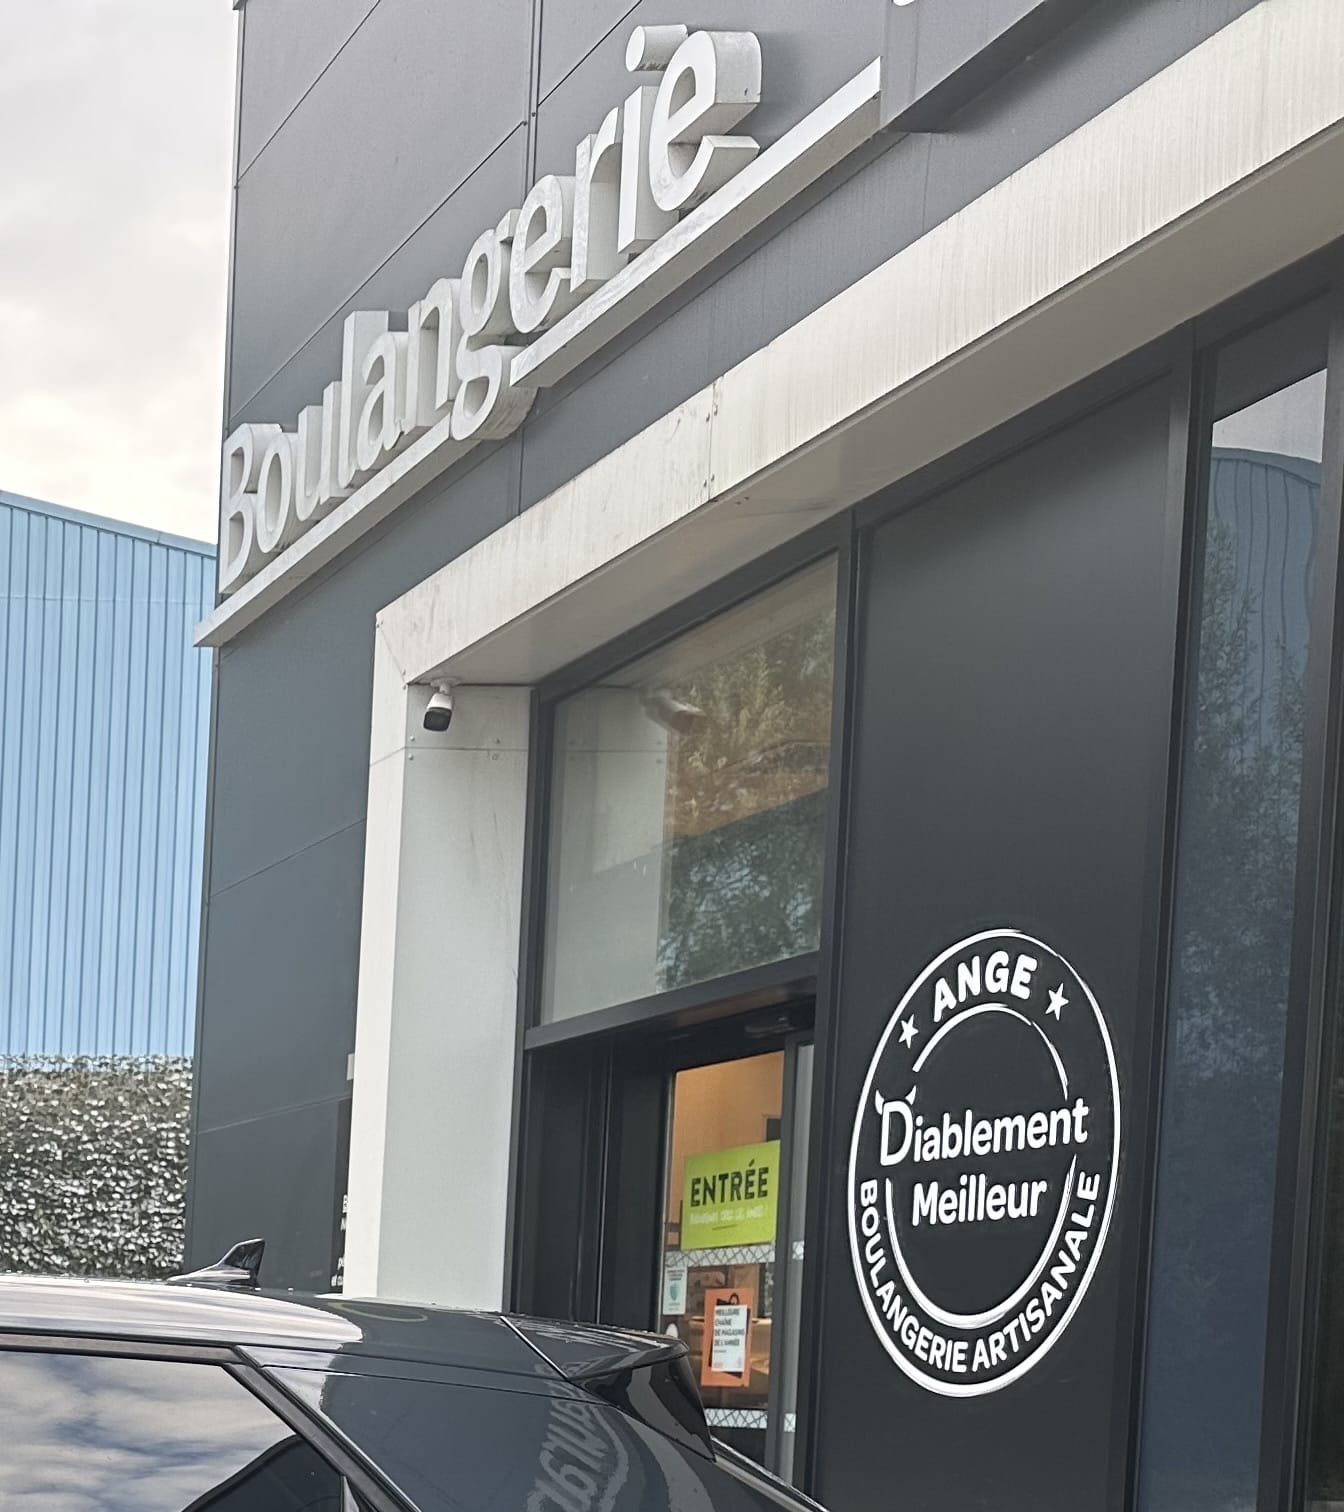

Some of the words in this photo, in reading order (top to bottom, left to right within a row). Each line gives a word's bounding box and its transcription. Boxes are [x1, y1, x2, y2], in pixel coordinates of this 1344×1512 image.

[218, 25, 760, 595] Boulangerie
[933, 950, 1038, 1022] ANGE
[875, 1087, 1089, 1166] Diablement
[690, 1158, 769, 1207] ENTRÉE
[912, 1173, 1047, 1226] Meilleur
[861, 1179, 968, 1373] BOULANGERIE
[971, 1171, 1100, 1372] ARTISANALE
